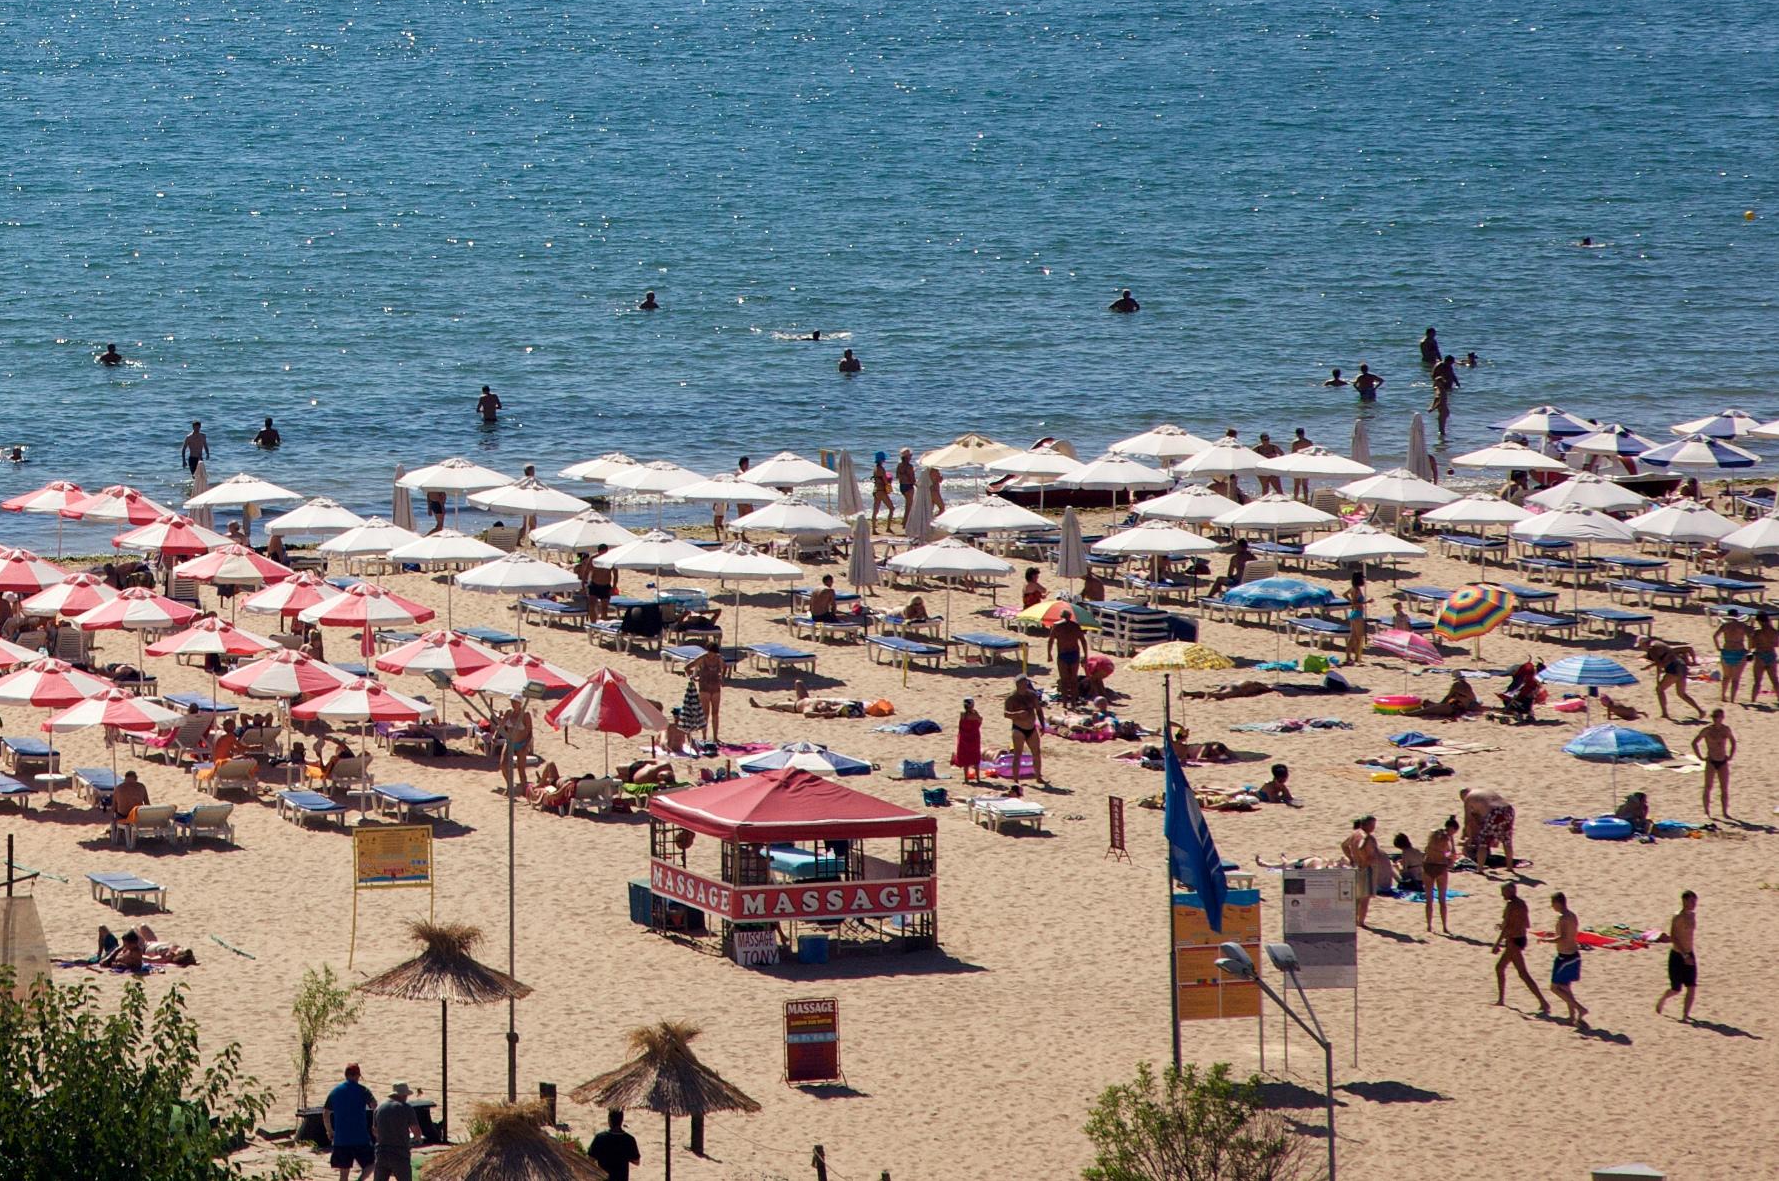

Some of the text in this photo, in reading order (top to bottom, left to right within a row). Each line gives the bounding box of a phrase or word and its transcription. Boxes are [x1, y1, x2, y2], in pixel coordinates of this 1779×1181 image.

[653, 864, 730, 911] MASSAGE
[741, 885, 928, 916] MASSAGE
[737, 930, 774, 947] MASSAGE
[743, 949, 780, 966] TONY
[787, 1001, 834, 1015] MASSAGE
